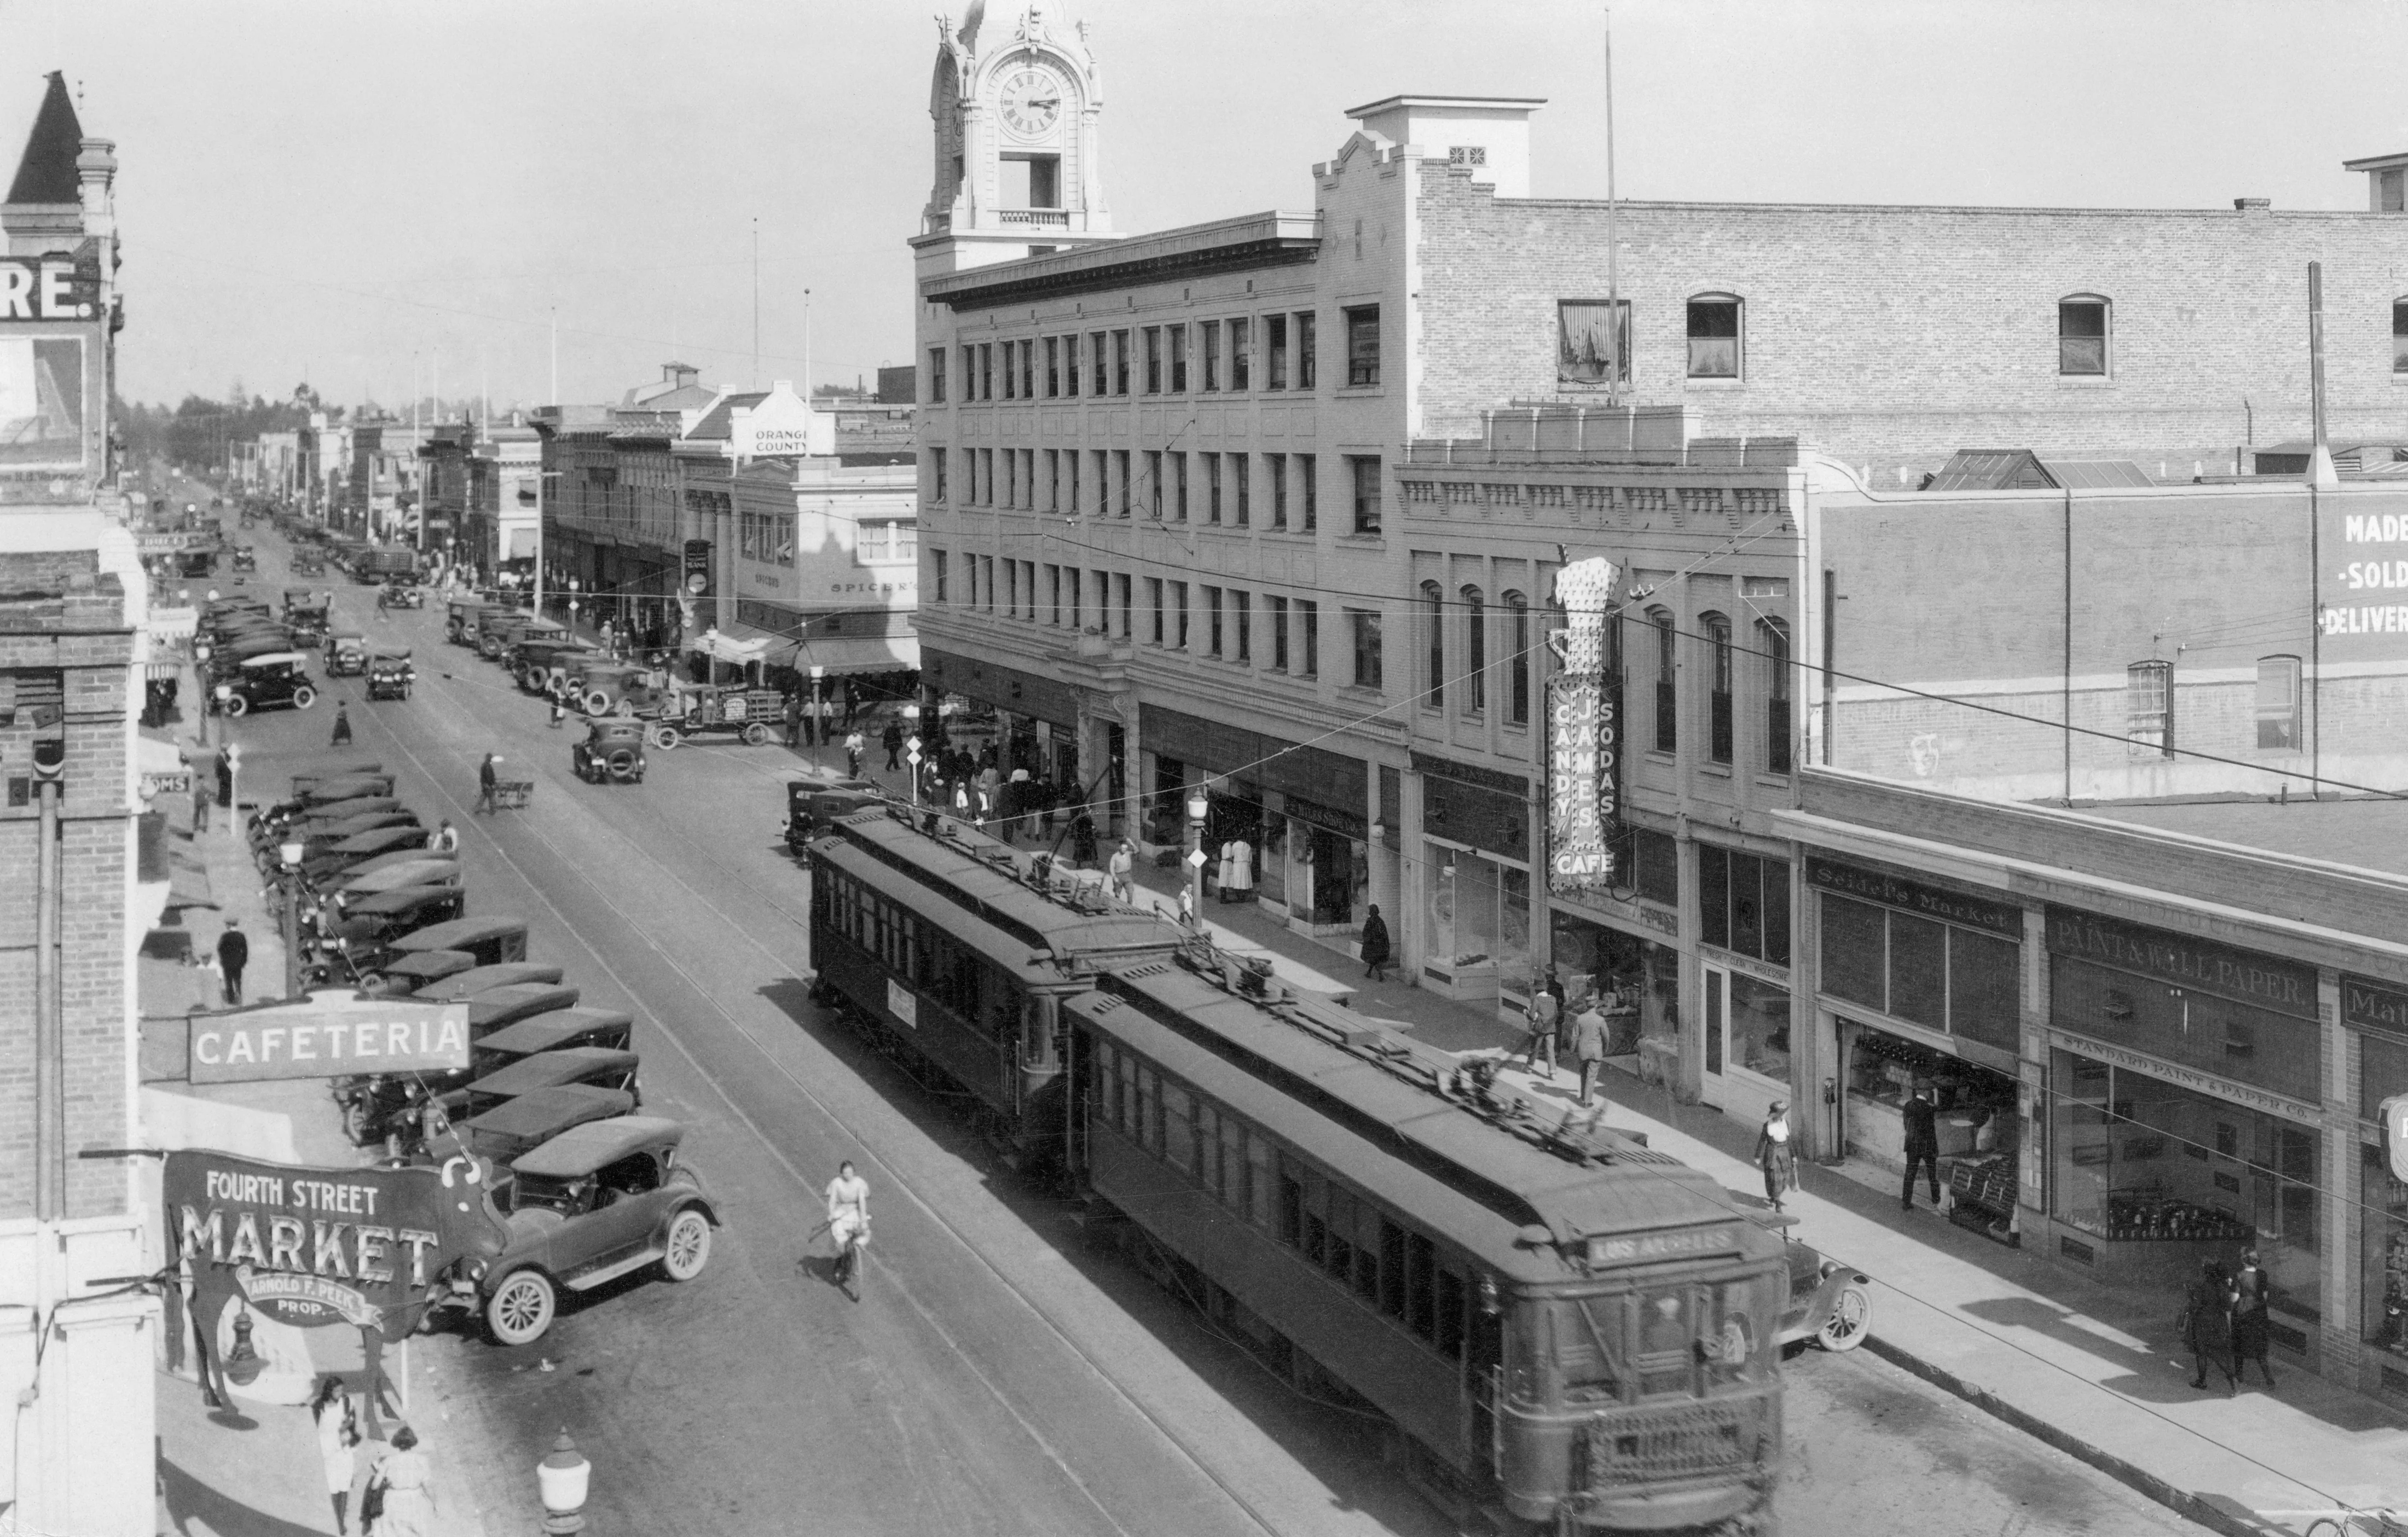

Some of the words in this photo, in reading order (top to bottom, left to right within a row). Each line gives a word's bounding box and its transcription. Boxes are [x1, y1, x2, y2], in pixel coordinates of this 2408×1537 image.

[2346, 514, 2408, 542] MADE
[1554, 704, 1572, 817] CANDY
[1576, 699, 1594, 828] JAMES
[1599, 703, 1615, 815] SODAS
[1556, 853, 1615, 875] CAFE
[1920, 893, 2006, 928] Market
[1706, 949, 1722, 961] FRESH
[1753, 965, 1788, 982] WHOLESOME
[2057, 921, 2126, 960] PAINT
[2128, 940, 2145, 965] &
[2147, 943, 2212, 982] WALL
[195, 1020, 463, 1066] CAFETERIA
[2063, 1035, 2147, 1070] STANDARD
[2152, 1063, 2204, 1087] PAINT
[2208, 1077, 2217, 1091] &
[2221, 1083, 2282, 1110] PAPER
[2286, 1104, 2308, 1118] CO.
[206, 1170, 284, 1206] FOURTH
[292, 1180, 379, 1215] STREET
[181, 1205, 439, 1287] MARKET
[250, 1278, 301, 1297] ARNOLD
[303, 1279, 316, 1295] F.
[318, 1283, 356, 1311] PEEK
[277, 1299, 327, 1315] PROP.
